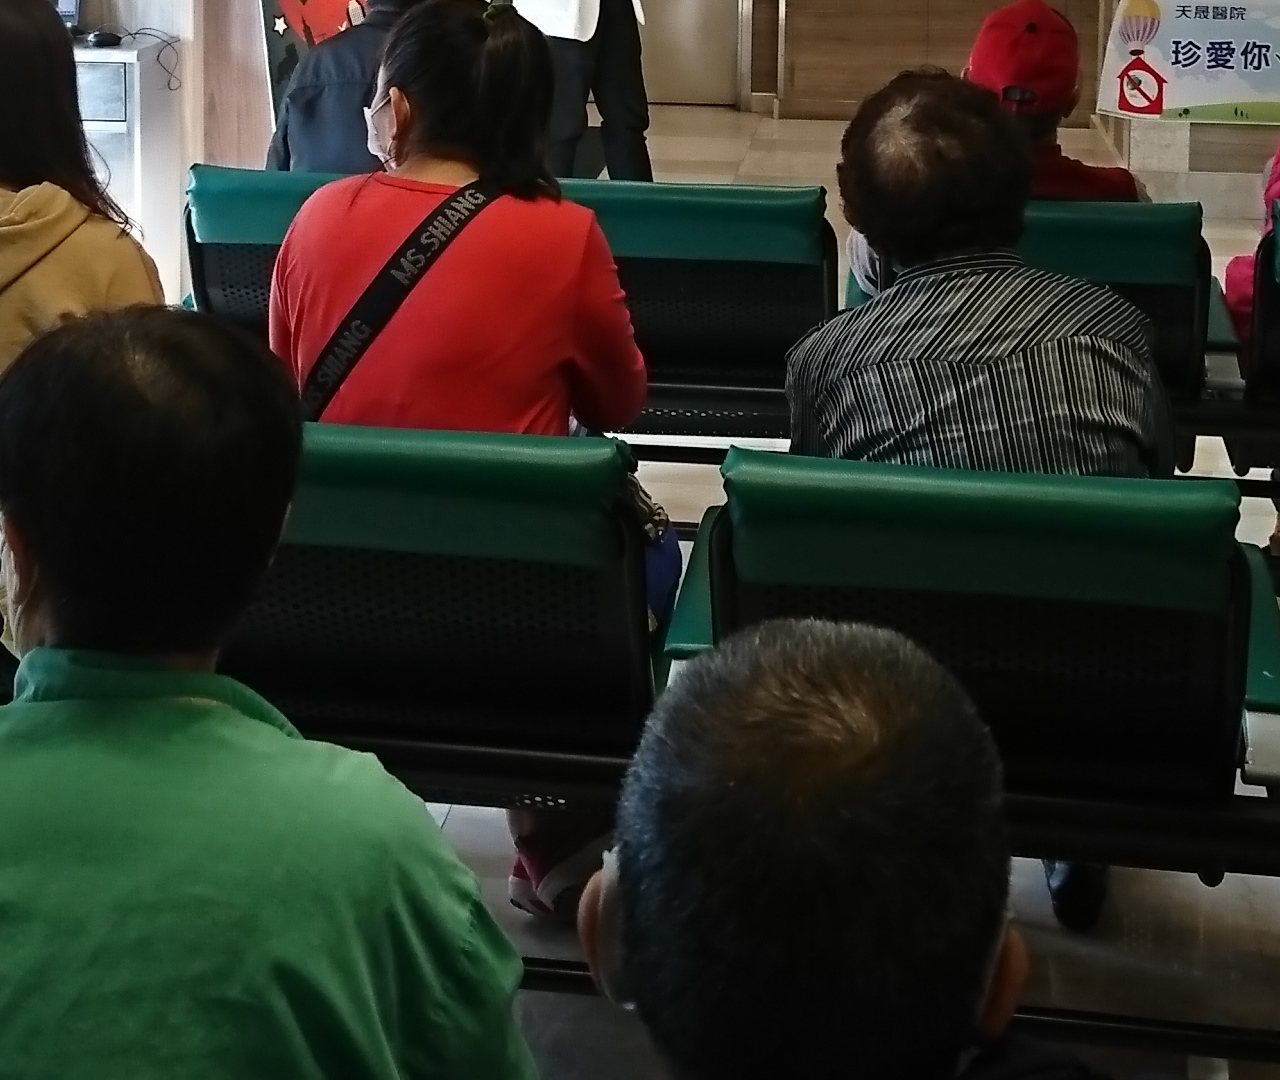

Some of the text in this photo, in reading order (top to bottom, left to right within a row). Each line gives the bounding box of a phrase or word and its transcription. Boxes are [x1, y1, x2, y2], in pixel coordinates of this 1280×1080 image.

[1175, 5, 1247, 20] 天晟醫院
[420, 190, 486, 250] SHIANG
[317, 320, 371, 387] SHIANG
